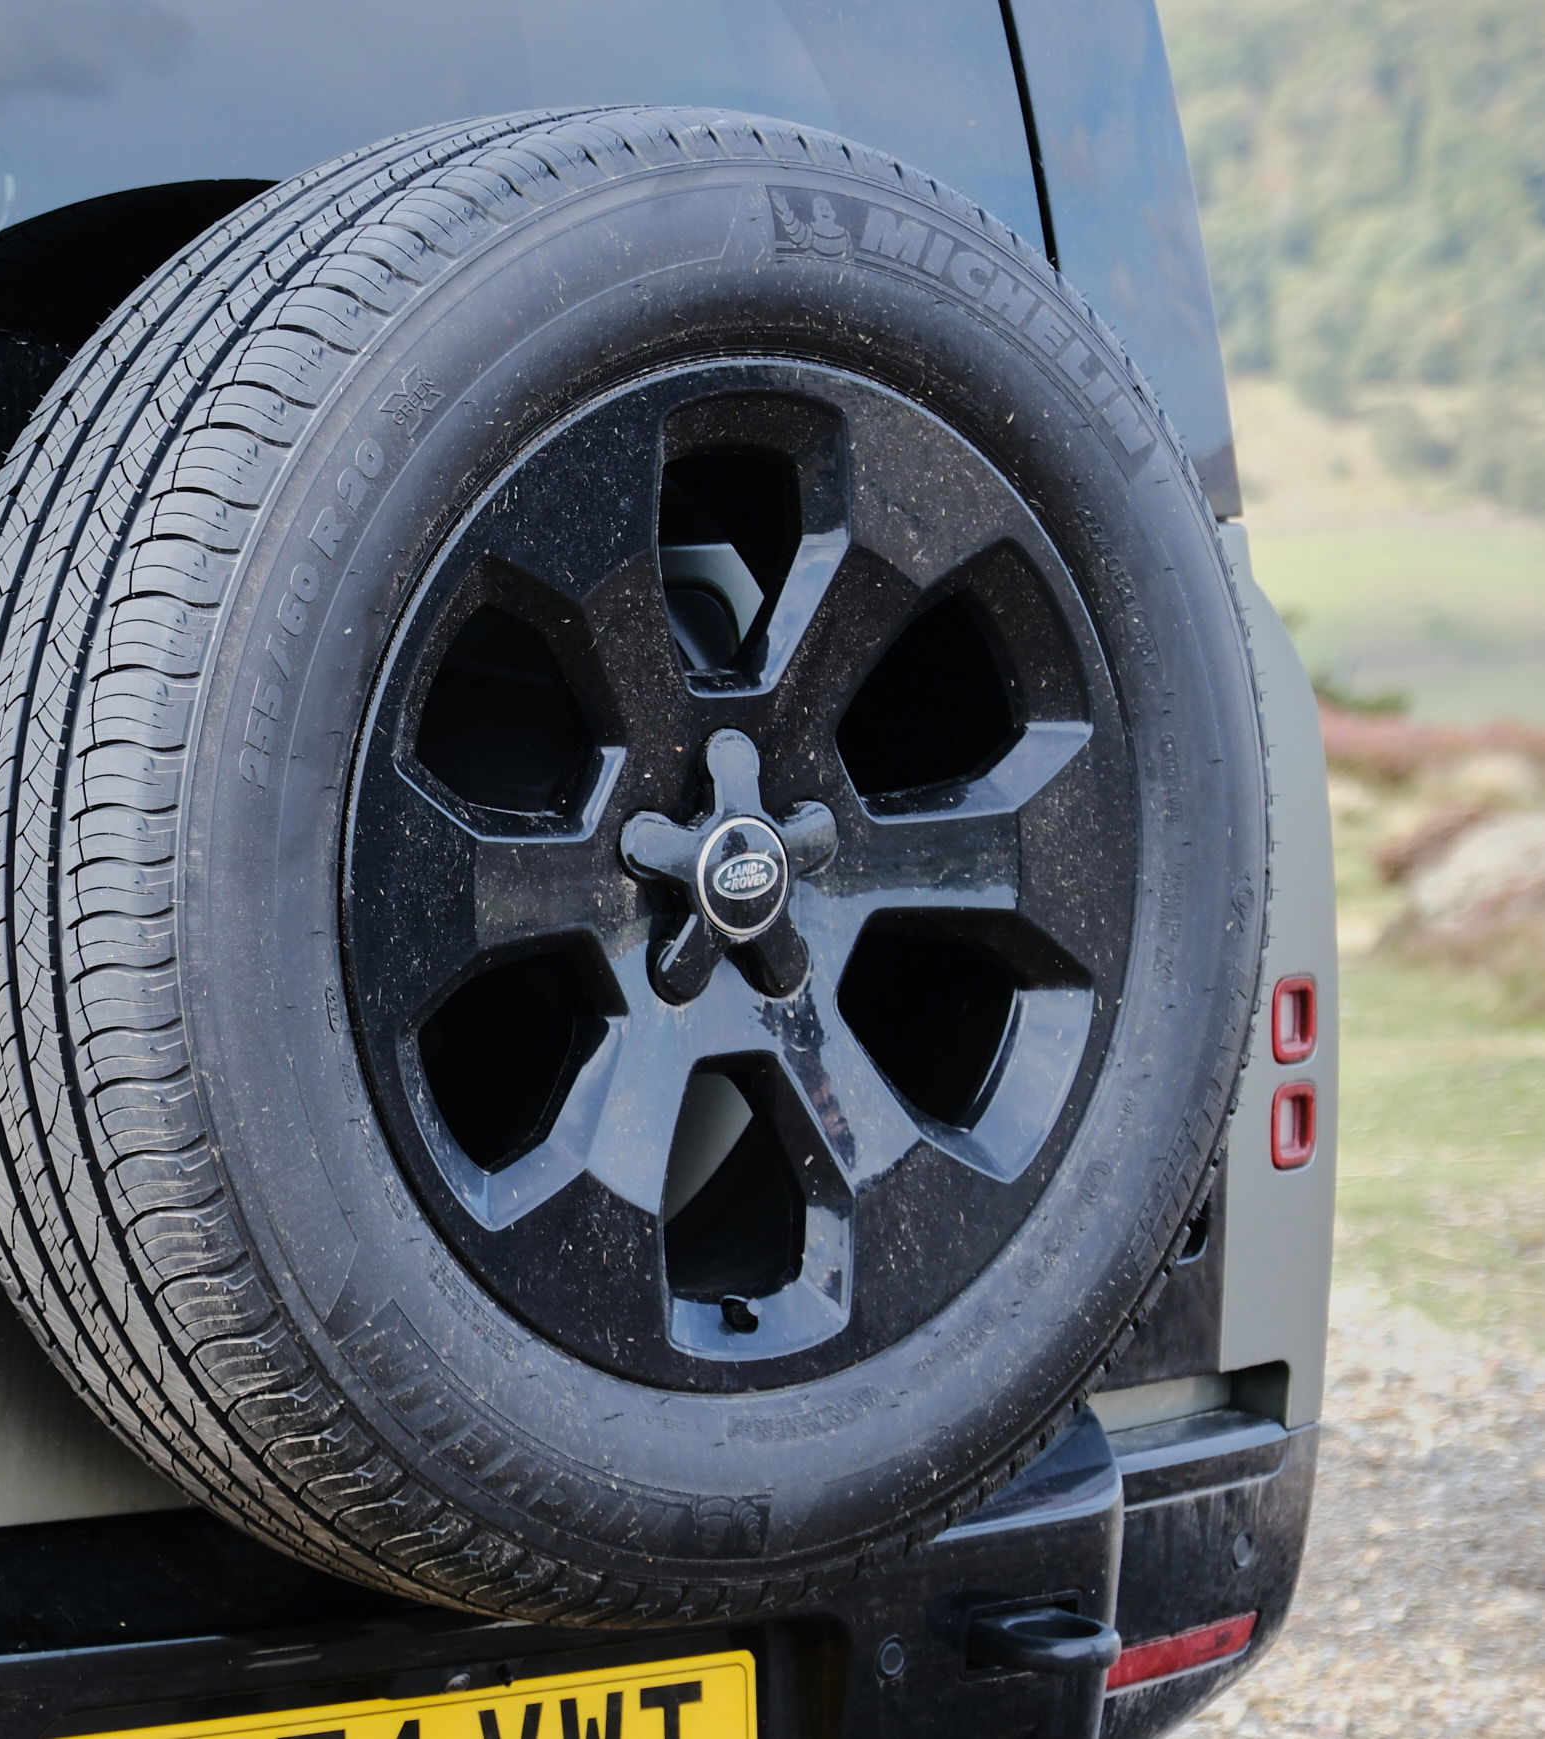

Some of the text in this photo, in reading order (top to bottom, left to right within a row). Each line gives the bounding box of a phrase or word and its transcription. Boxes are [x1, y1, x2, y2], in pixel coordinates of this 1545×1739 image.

[860, 208, 1157, 456] MICHELIN
[392, 377, 435, 426] GREEN
[727, 862, 758, 879] LAND
[731, 874, 767, 891] ROVER
